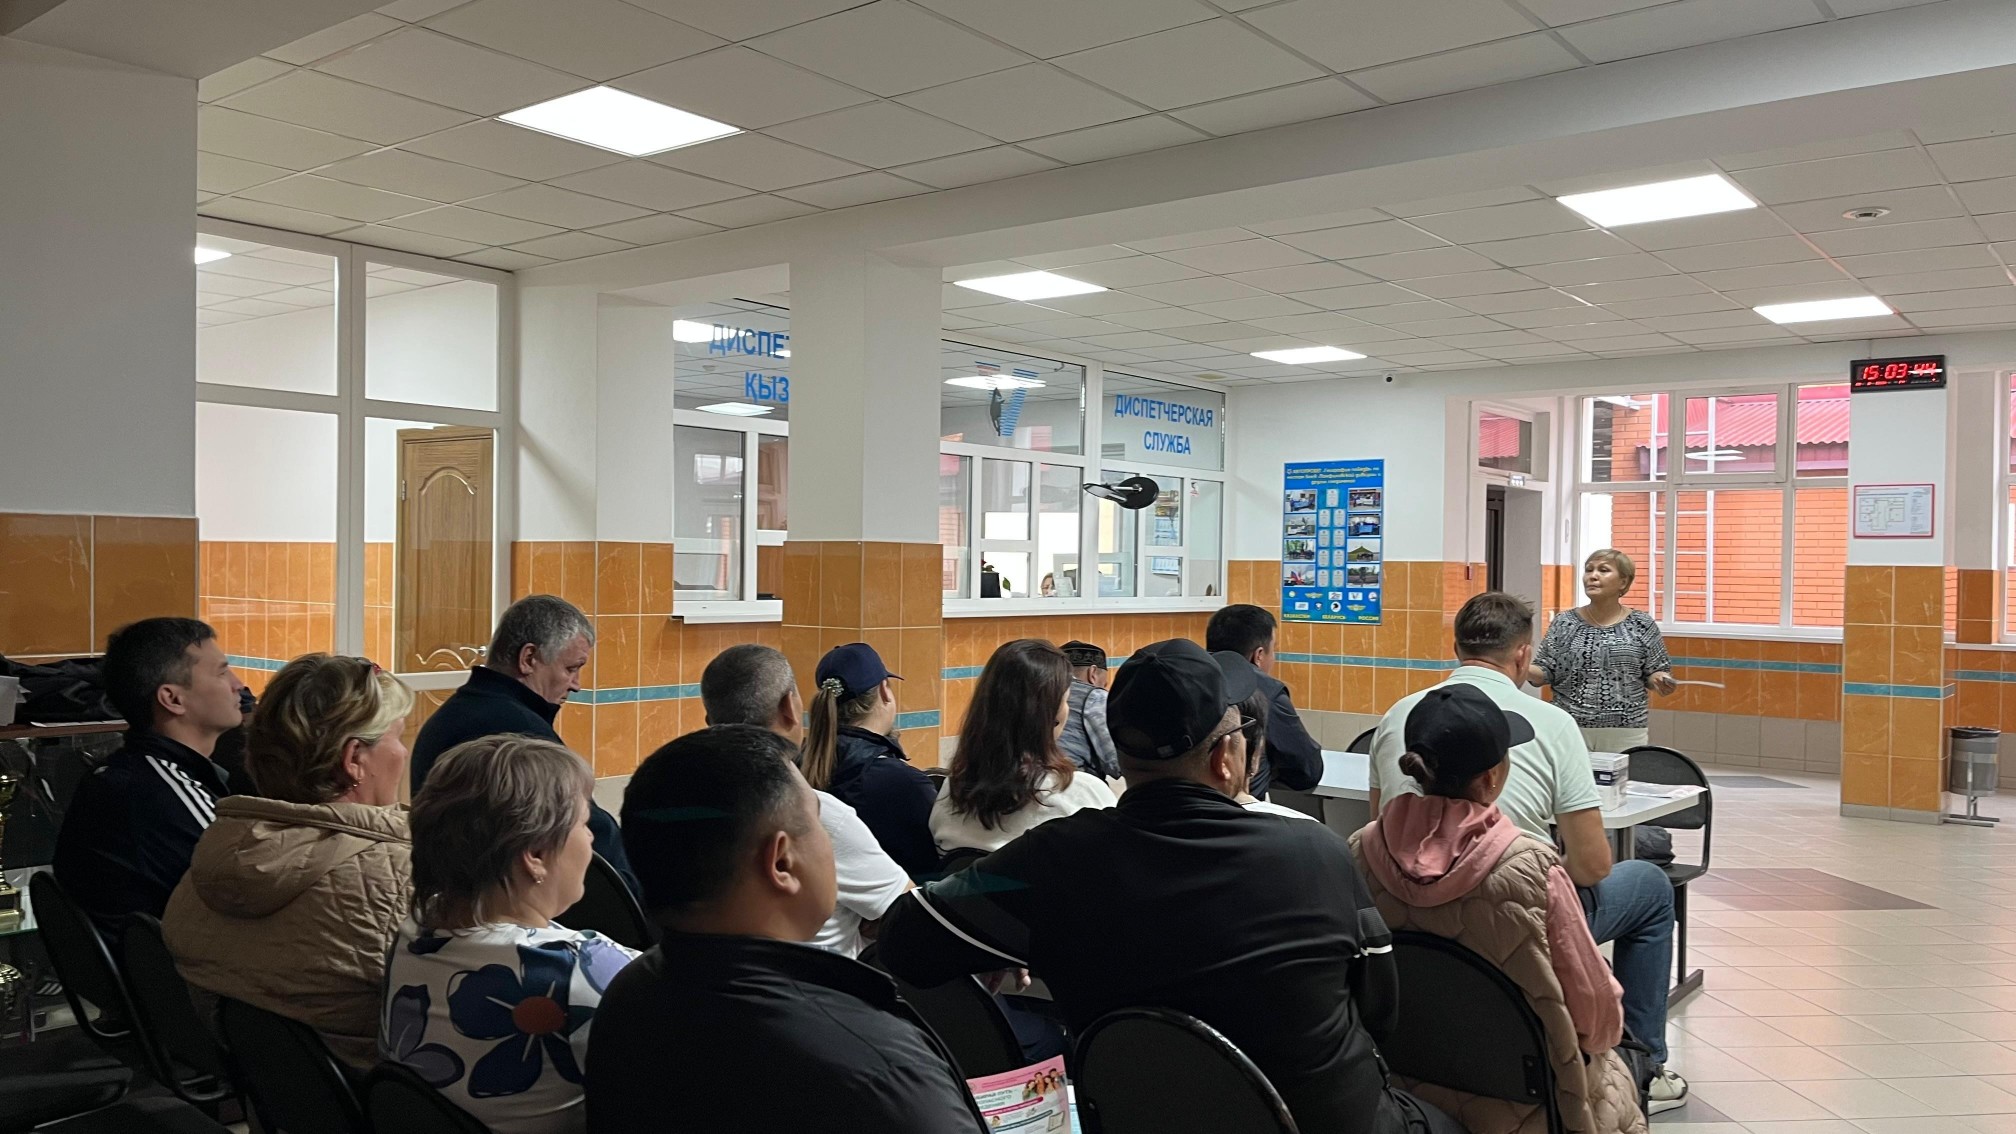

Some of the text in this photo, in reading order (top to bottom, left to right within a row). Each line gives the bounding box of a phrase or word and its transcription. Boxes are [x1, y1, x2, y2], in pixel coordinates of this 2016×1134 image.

[709, 323, 789, 359] ДИСПЕ
[1114, 394, 1213, 428] ДИСПЕТЧЕРСКАЯ
[1144, 431, 1191, 455] СЛУЖБА
